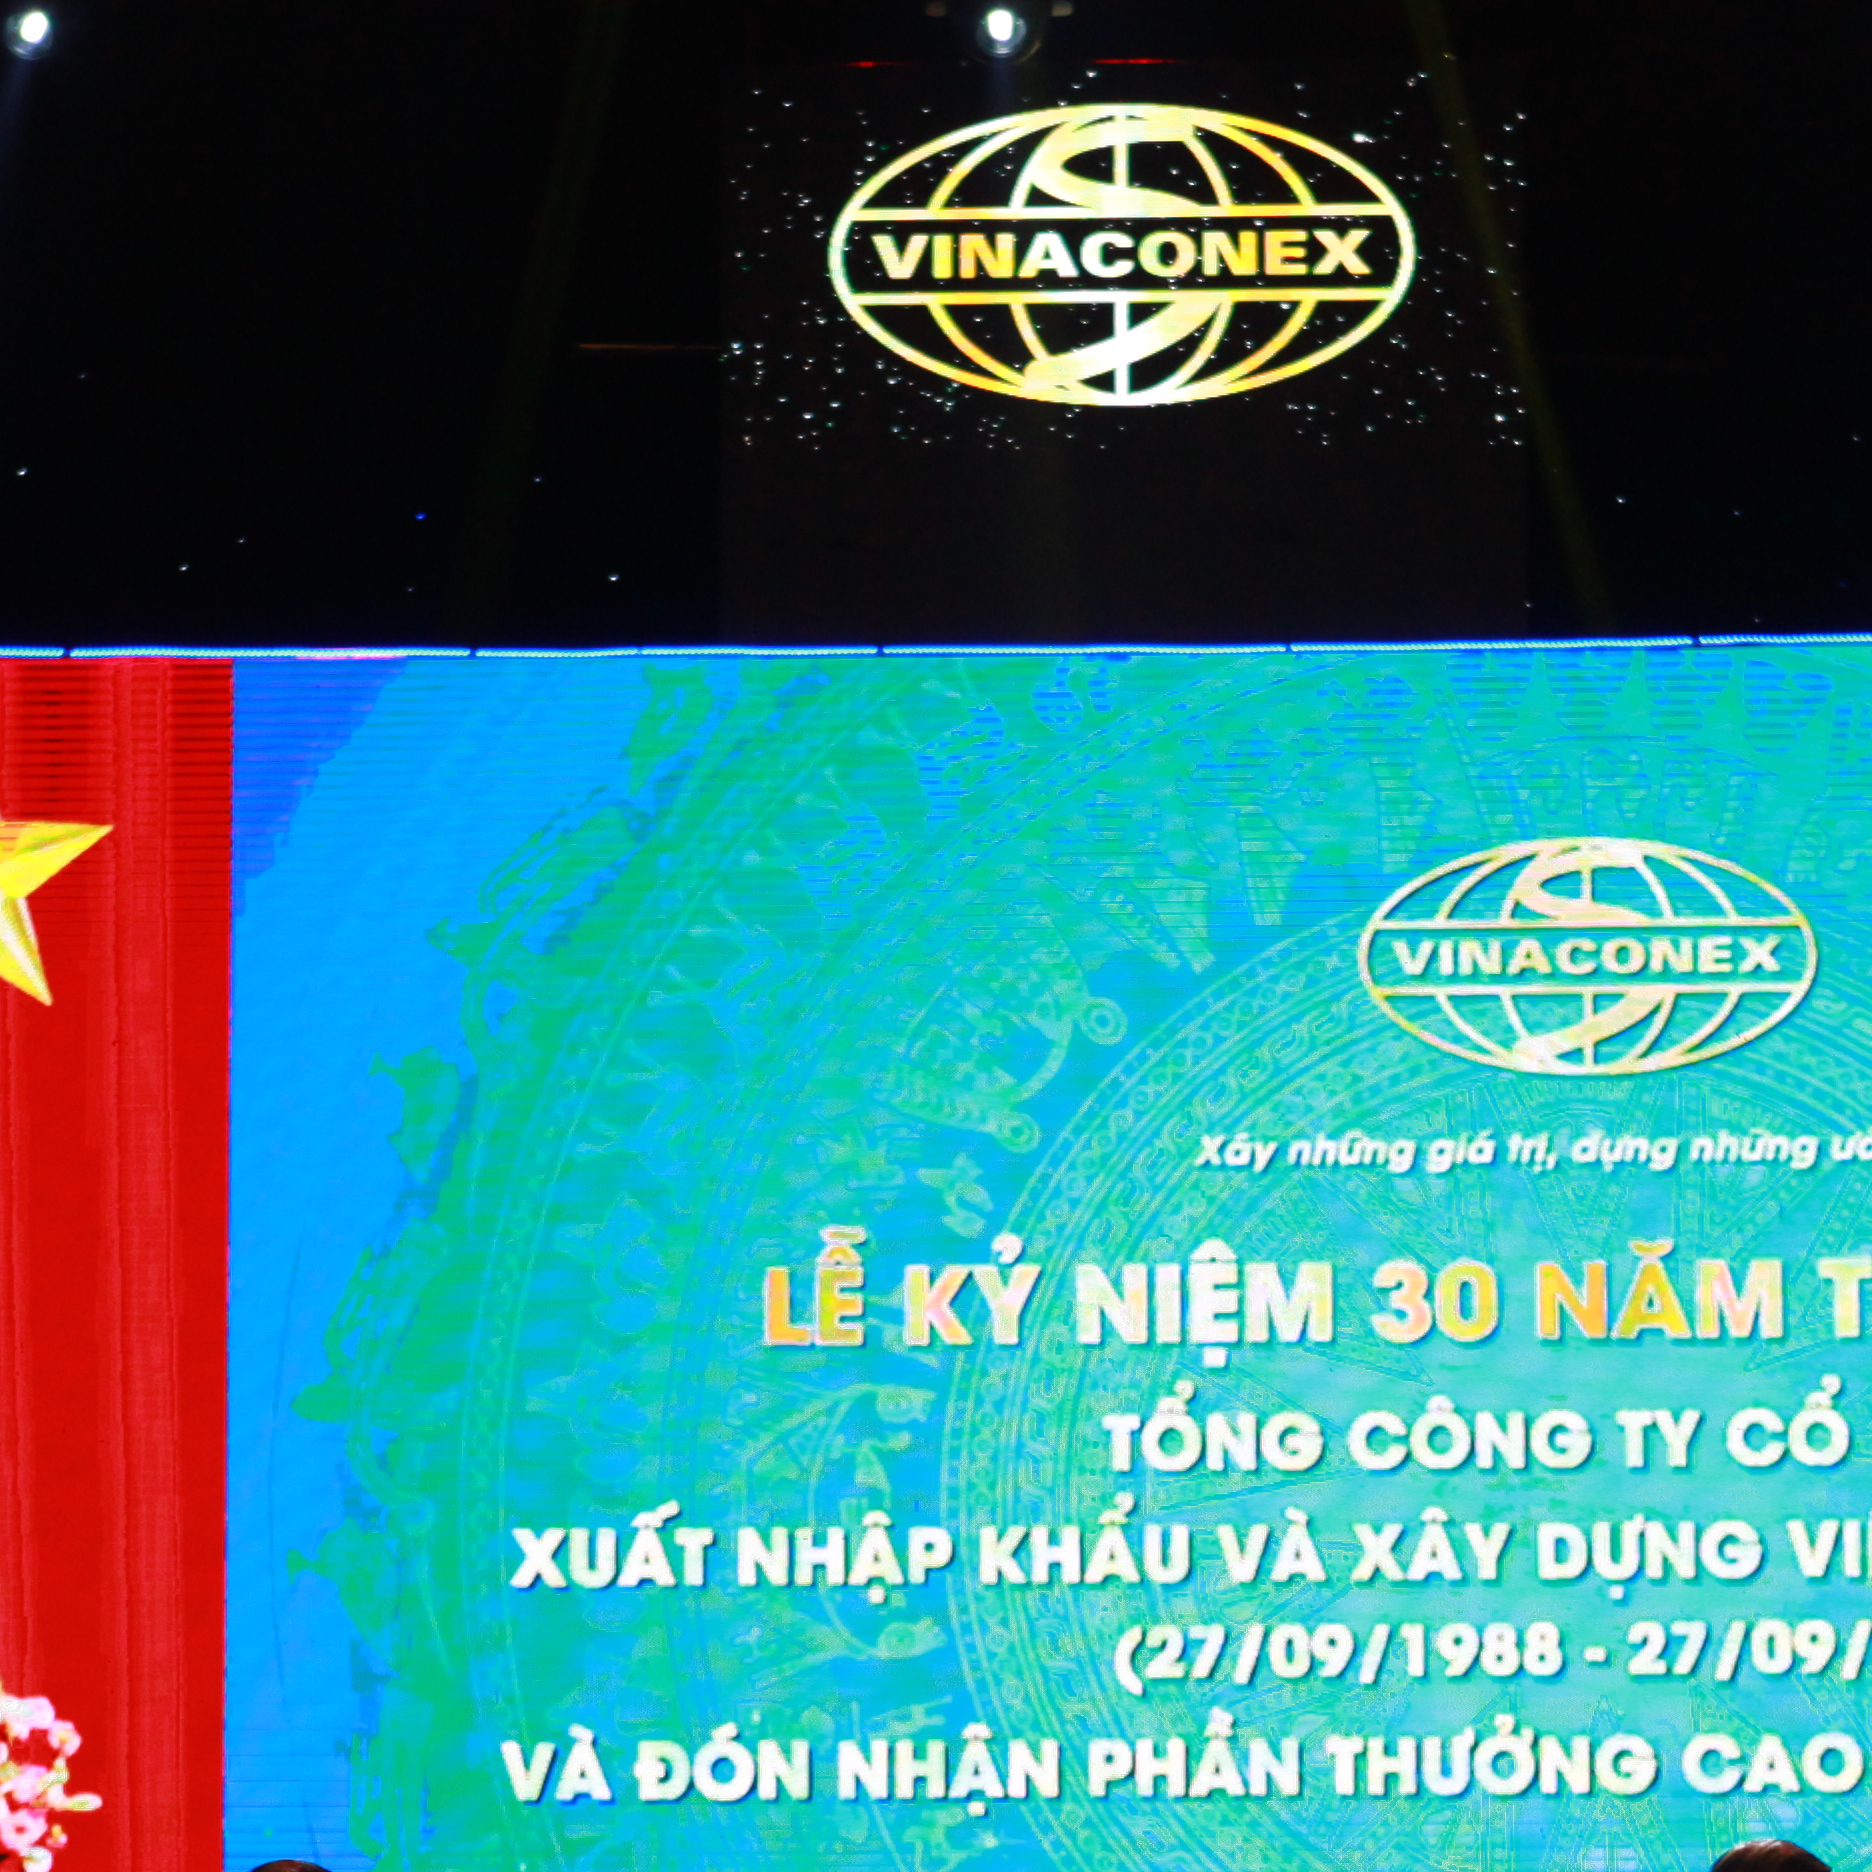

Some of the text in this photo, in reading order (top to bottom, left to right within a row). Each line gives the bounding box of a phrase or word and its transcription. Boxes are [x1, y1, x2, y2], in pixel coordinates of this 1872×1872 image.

[872, 229, 1371, 279] VINACONEX
[1393, 933, 1781, 976] VINACONEX
[1196, 1133, 1276, 1171] Xây
[1289, 1132, 1415, 1172] những
[1427, 1131, 1494, 1172] giá
[1509, 1134, 1556, 1172] trị,
[1572, 1131, 1678, 1170] dựng
[1691, 1131, 1818, 1169] những
[765, 1226, 864, 1345] LỄ
[904, 1234, 1040, 1345] KỶ
[1076, 1240, 1332, 1366] NIỆM
[1372, 1260, 1497, 1342] 30
[1536, 1240, 1782, 1338] NĂM
[1103, 1381, 1322, 1471] TỔNG
[1348, 1396, 1590, 1469] CÔNG
[1617, 1410, 1699, 1466] TY
[1728, 1376, 1848, 1466] CỔ
[512, 1502, 712, 1587] XUẤT
[738, 1511, 951, 1603] NHẬP
[980, 1493, 1188, 1583] KHẨU
[1218, 1508, 1325, 1583] VÀ
[1352, 1507, 1509, 1579] XÂY
[1539, 1515, 1760, 1598] DỰNG
[1114, 1622, 1561, 1694] (27/09/1988
[502, 1727, 610, 1799] VÀ
[634, 1723, 807, 1800] ĐÓN
[838, 1724, 1058, 1815] NHẬN
[1089, 1708, 1298, 1797] PHẦN
[1325, 1715, 1656, 1794] THƯỞNG
[1683, 1733, 1862, 1792] CAO
